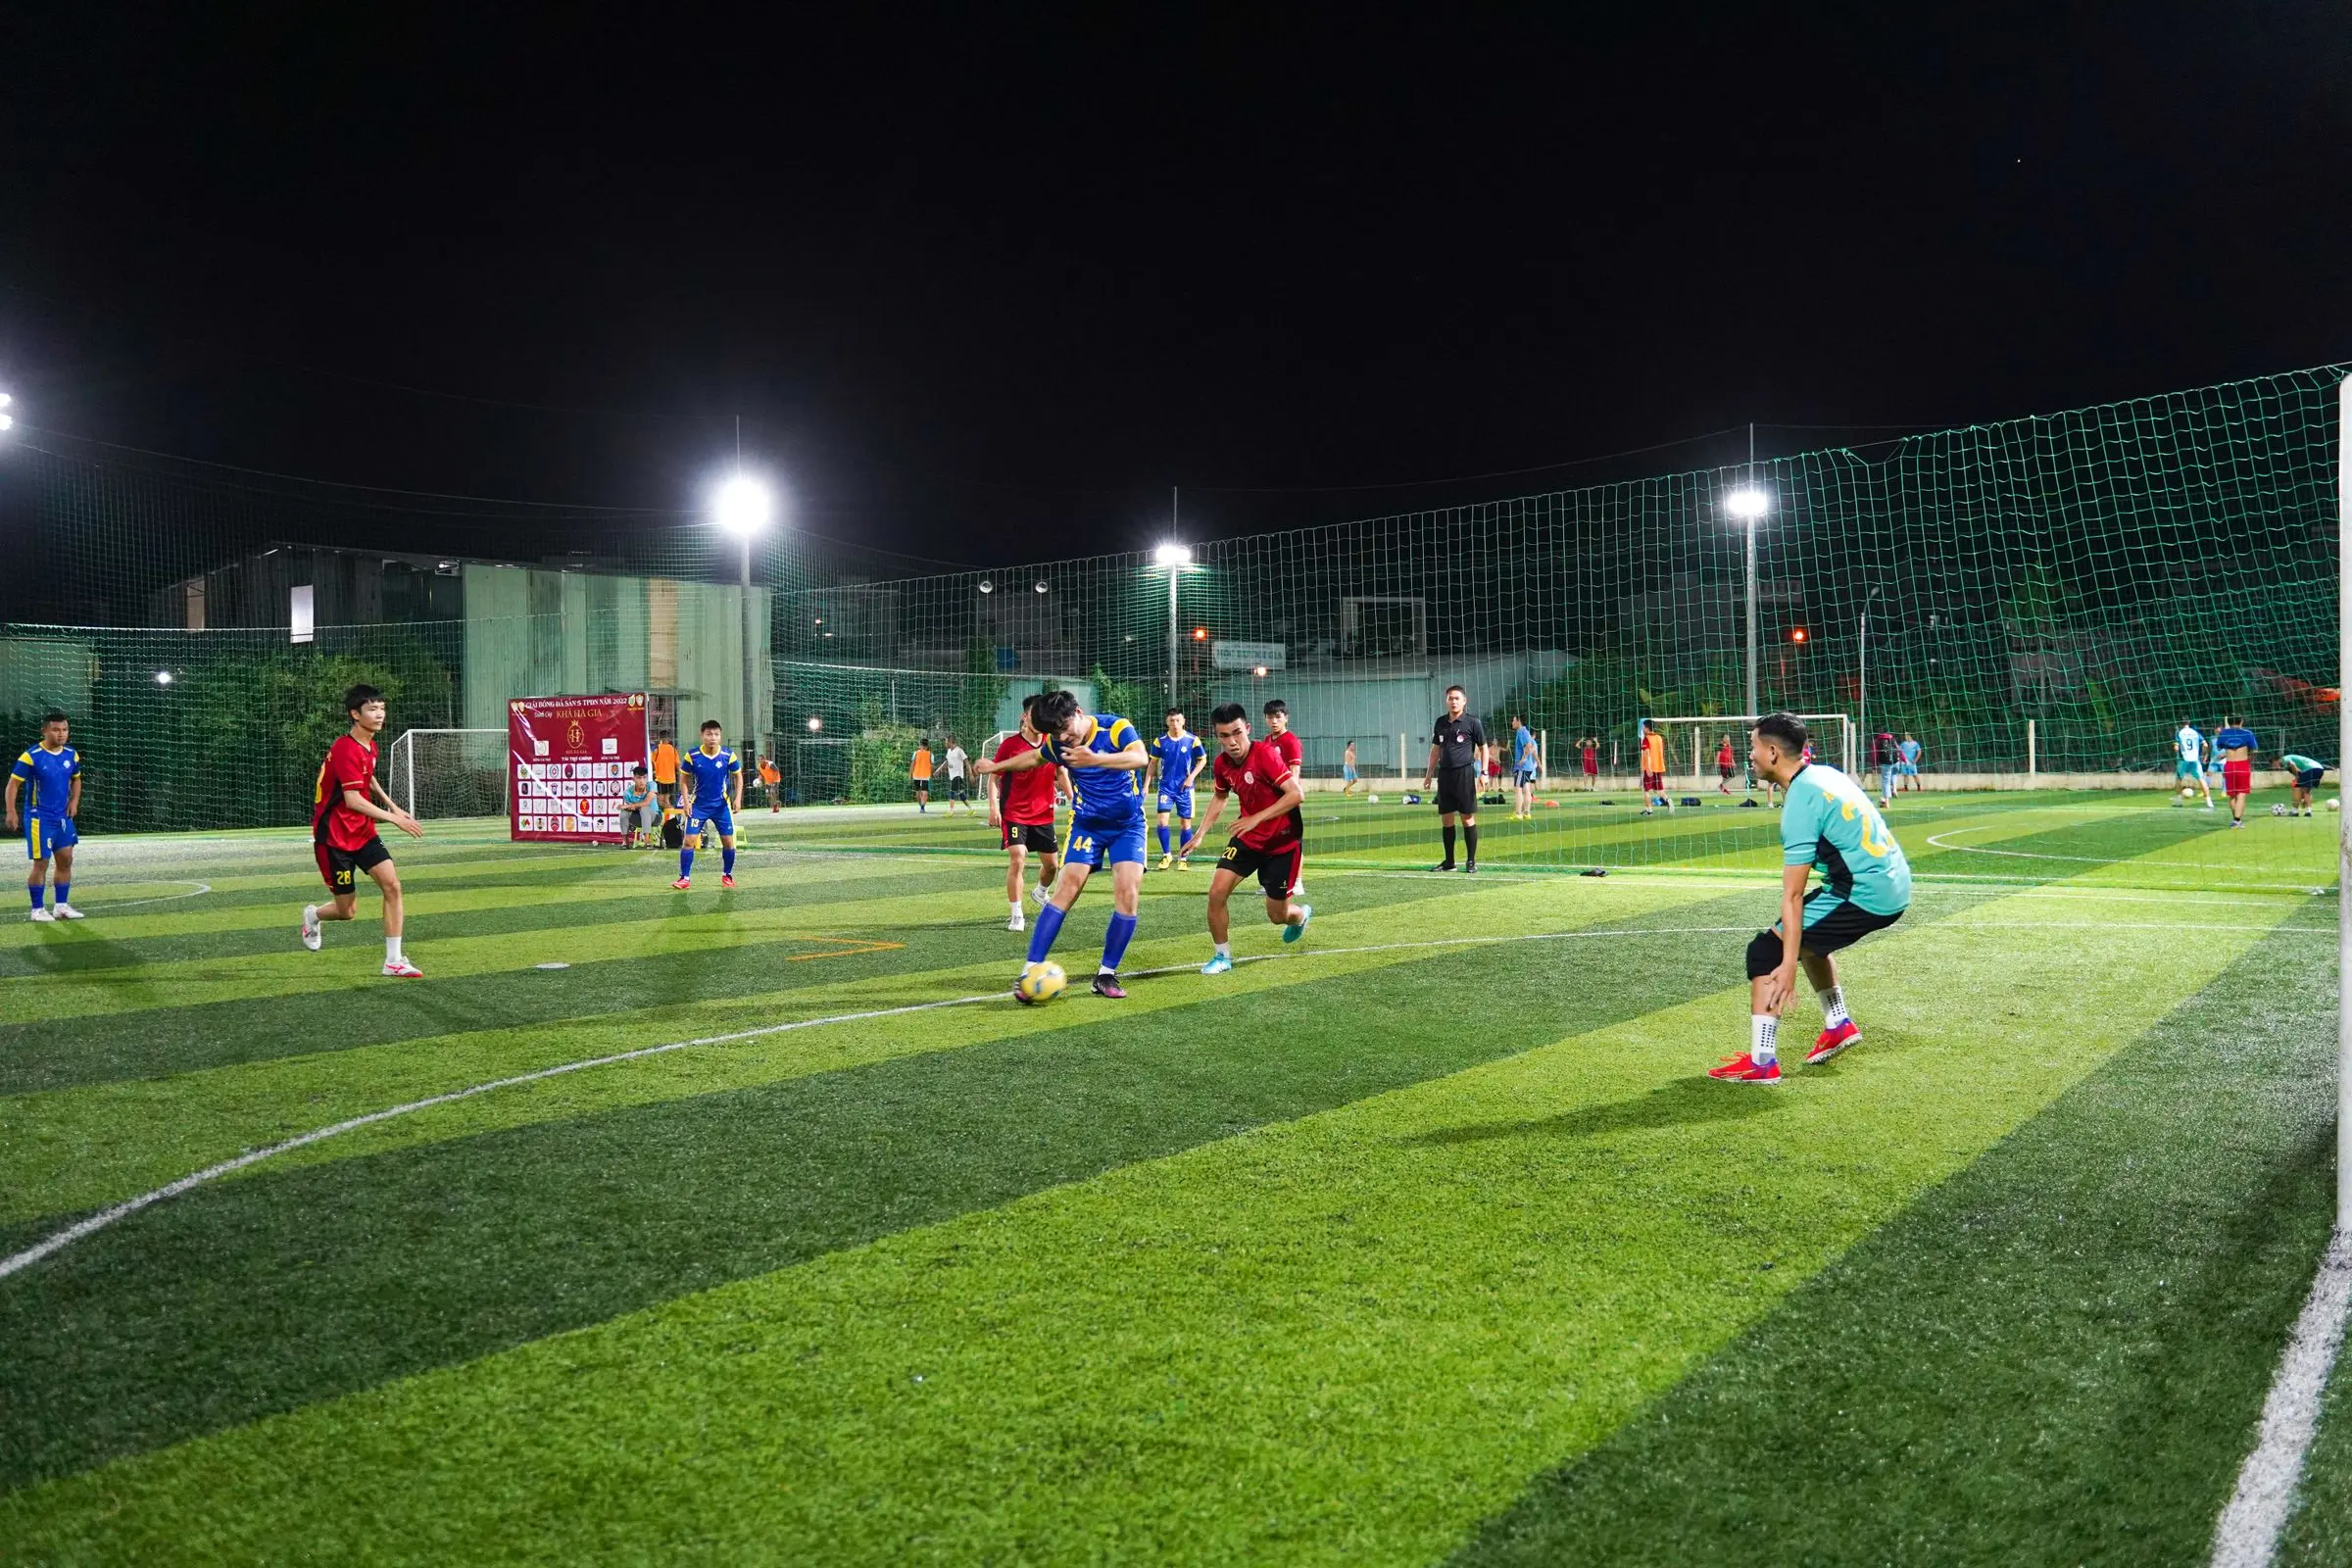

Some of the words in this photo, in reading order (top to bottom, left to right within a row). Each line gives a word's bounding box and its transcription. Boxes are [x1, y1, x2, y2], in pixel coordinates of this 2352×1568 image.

[587, 708, 603, 717] GIA
[2186, 738, 2193, 751] 9
[1011, 826, 1018, 838] 9
[1072, 835, 1093, 854] 44
[1222, 847, 1238, 860] 20
[336, 870, 352, 885] 28
